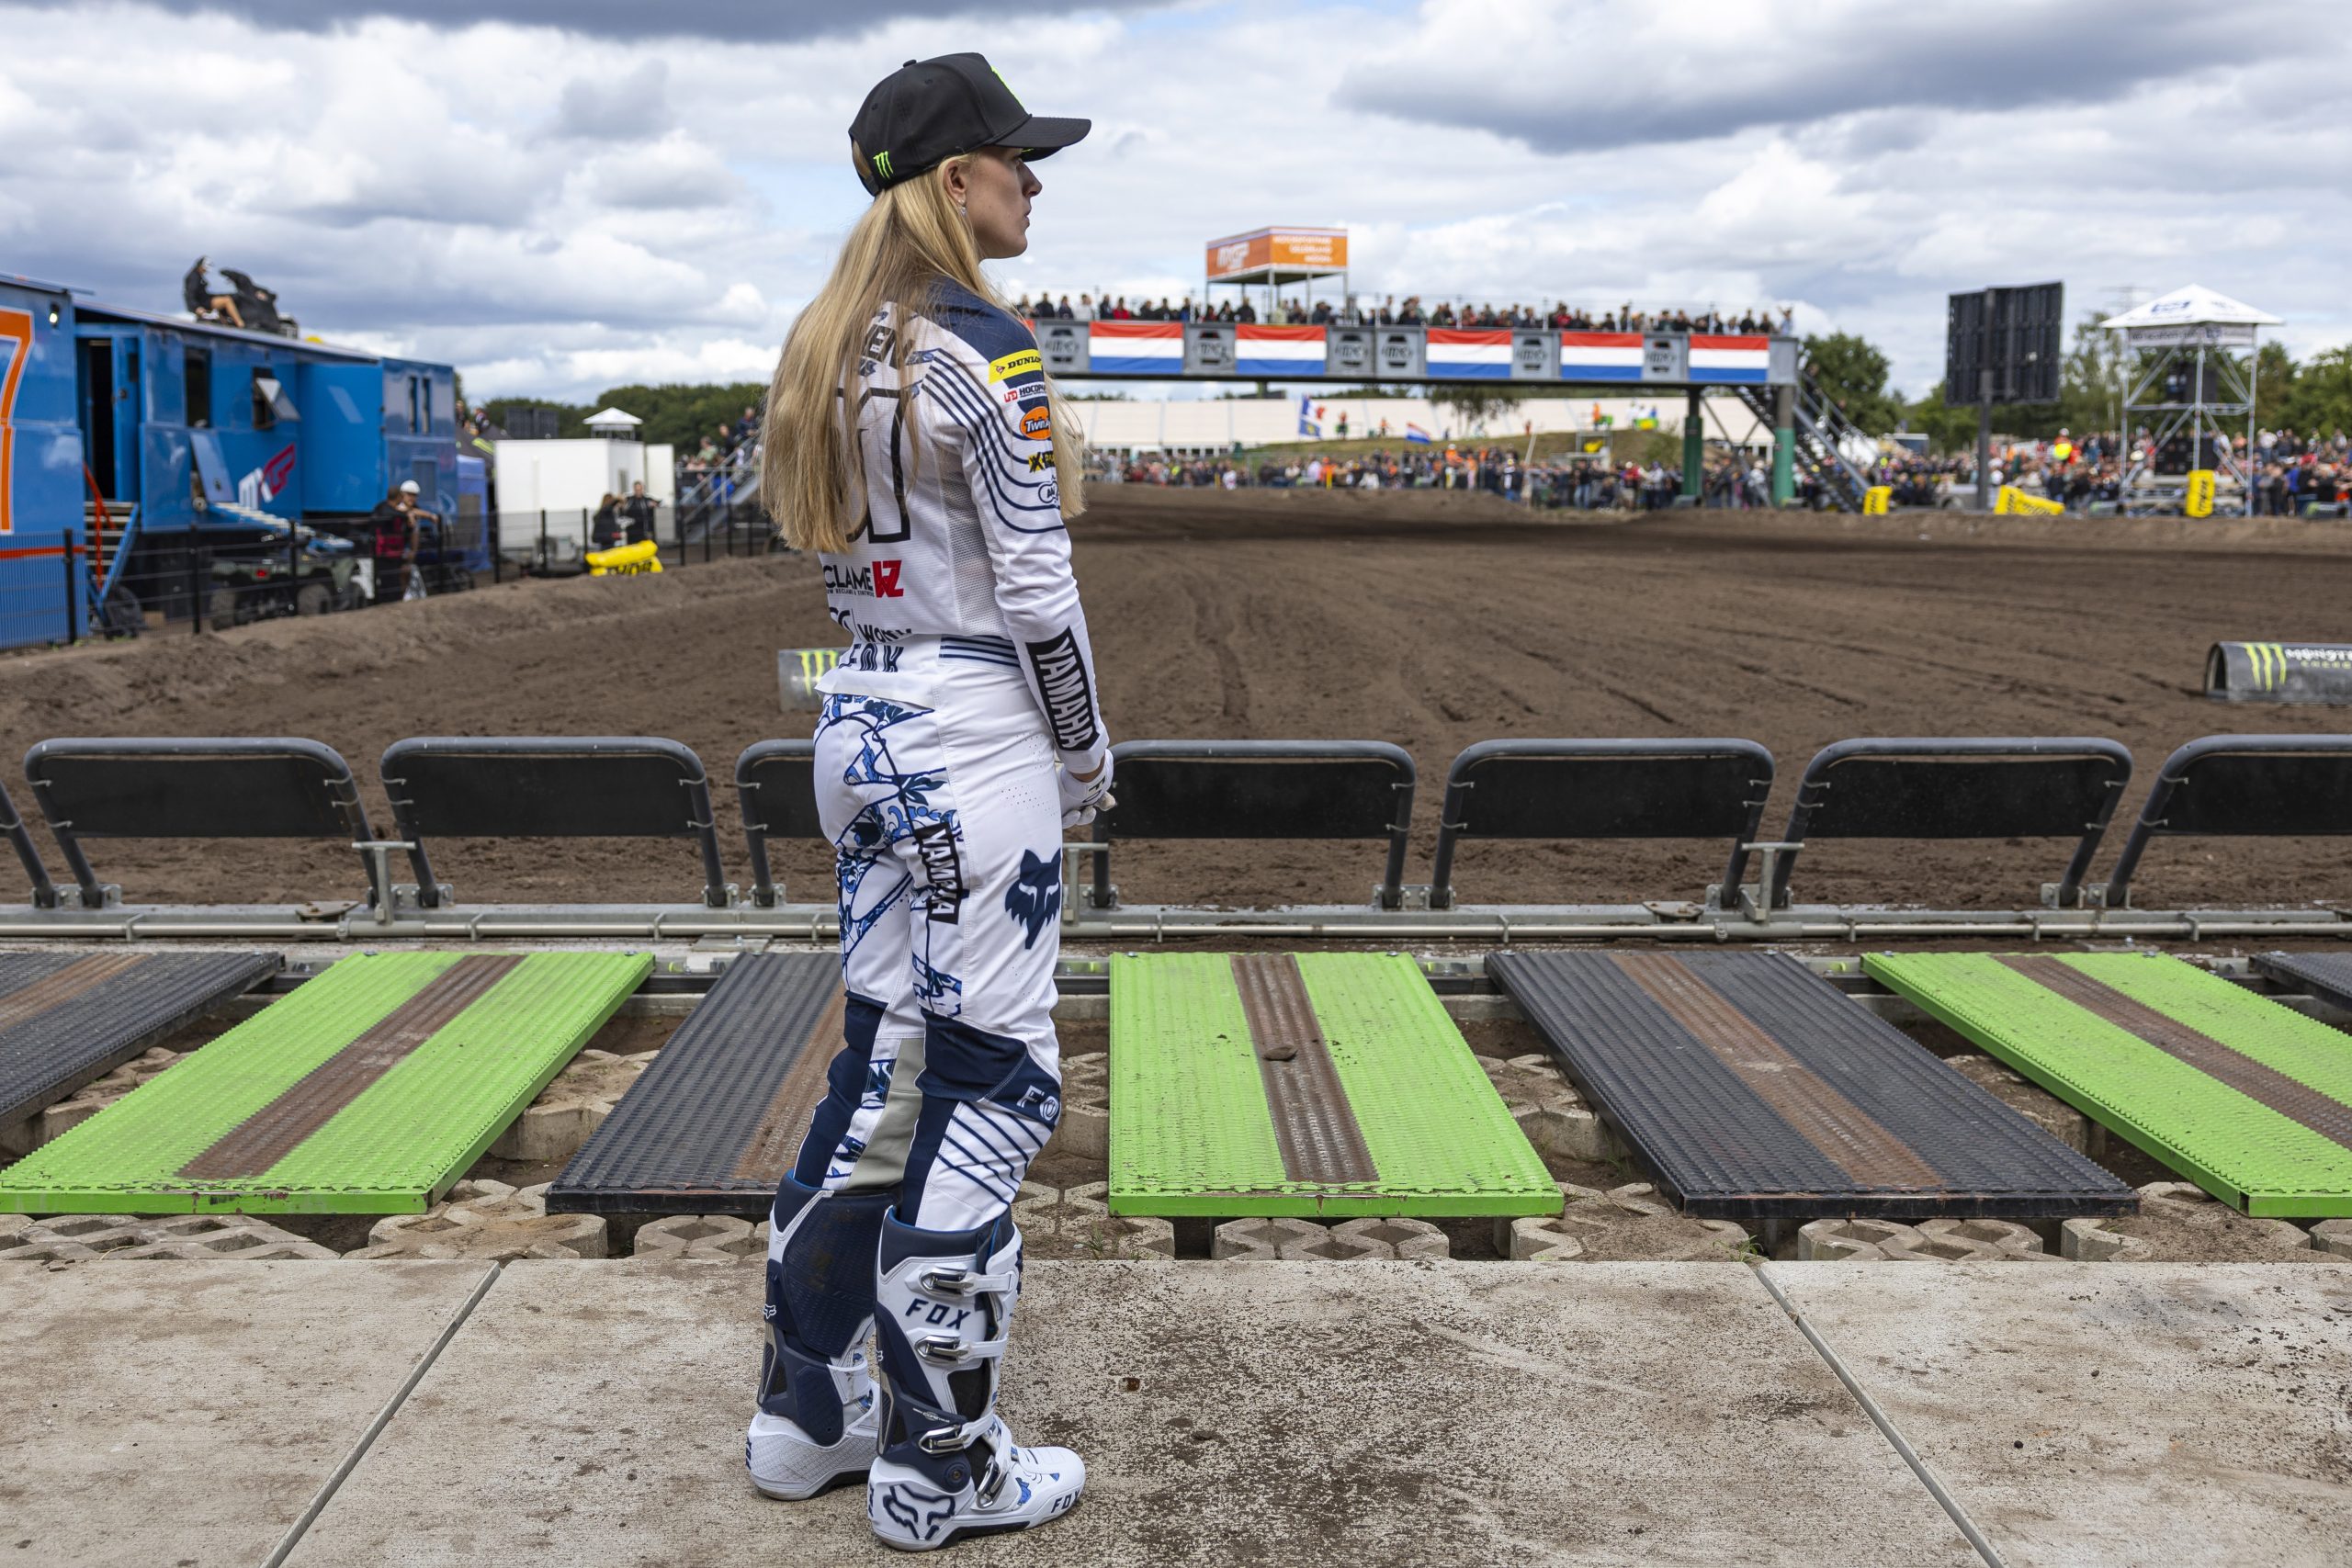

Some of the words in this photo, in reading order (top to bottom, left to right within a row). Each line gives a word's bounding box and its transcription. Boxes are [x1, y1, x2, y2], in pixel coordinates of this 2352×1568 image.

[1007, 355, 1042, 369] DUNLO
[1019, 384, 1046, 396] HOCOPA
[823, 564, 874, 591] CLAME
[1035, 636, 1094, 749] YAMAHA
[1016, 1084, 1059, 1122] FO
[905, 1298, 971, 1330] FOX
[1051, 1489, 1080, 1514] FOX
